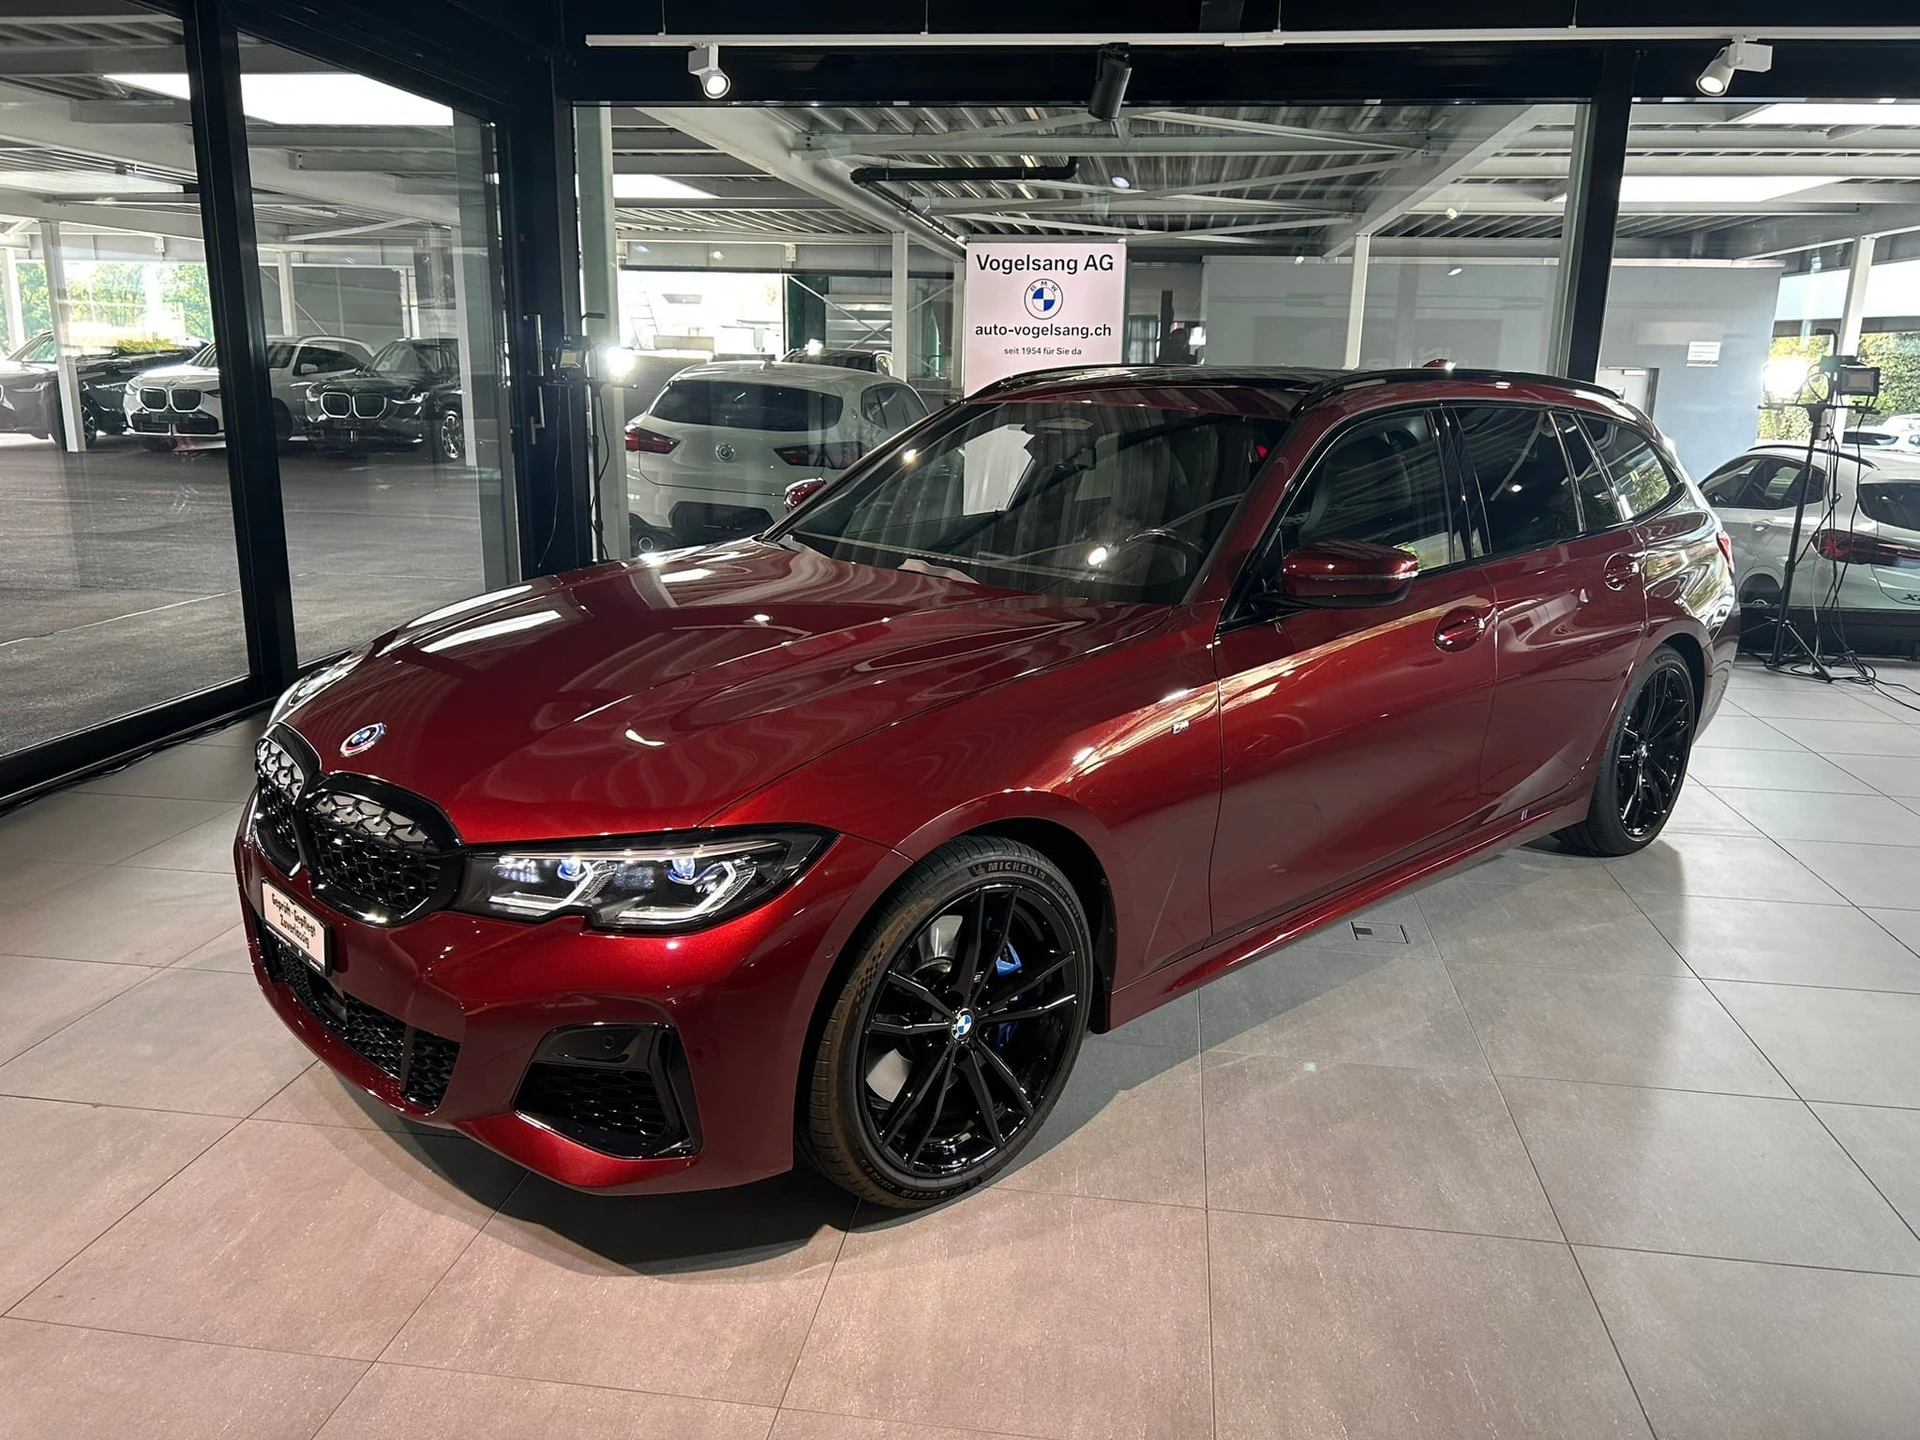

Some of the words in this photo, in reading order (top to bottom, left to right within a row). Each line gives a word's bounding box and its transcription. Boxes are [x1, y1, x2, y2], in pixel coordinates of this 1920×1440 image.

[976, 254, 1078, 275] Vogelsang
[1084, 254, 1114, 271] AG
[1030, 281, 1058, 292] BMW
[975, 323, 1112, 339] auto-vogelsang.ch
[1004, 346, 1019, 355] seit
[1021, 346, 1042, 355] 1954
[1043, 346, 1055, 355] für
[1056, 346, 1070, 356] Sie
[1071, 346, 1082, 355] da
[987, 861, 1047, 880] MICHELIN
